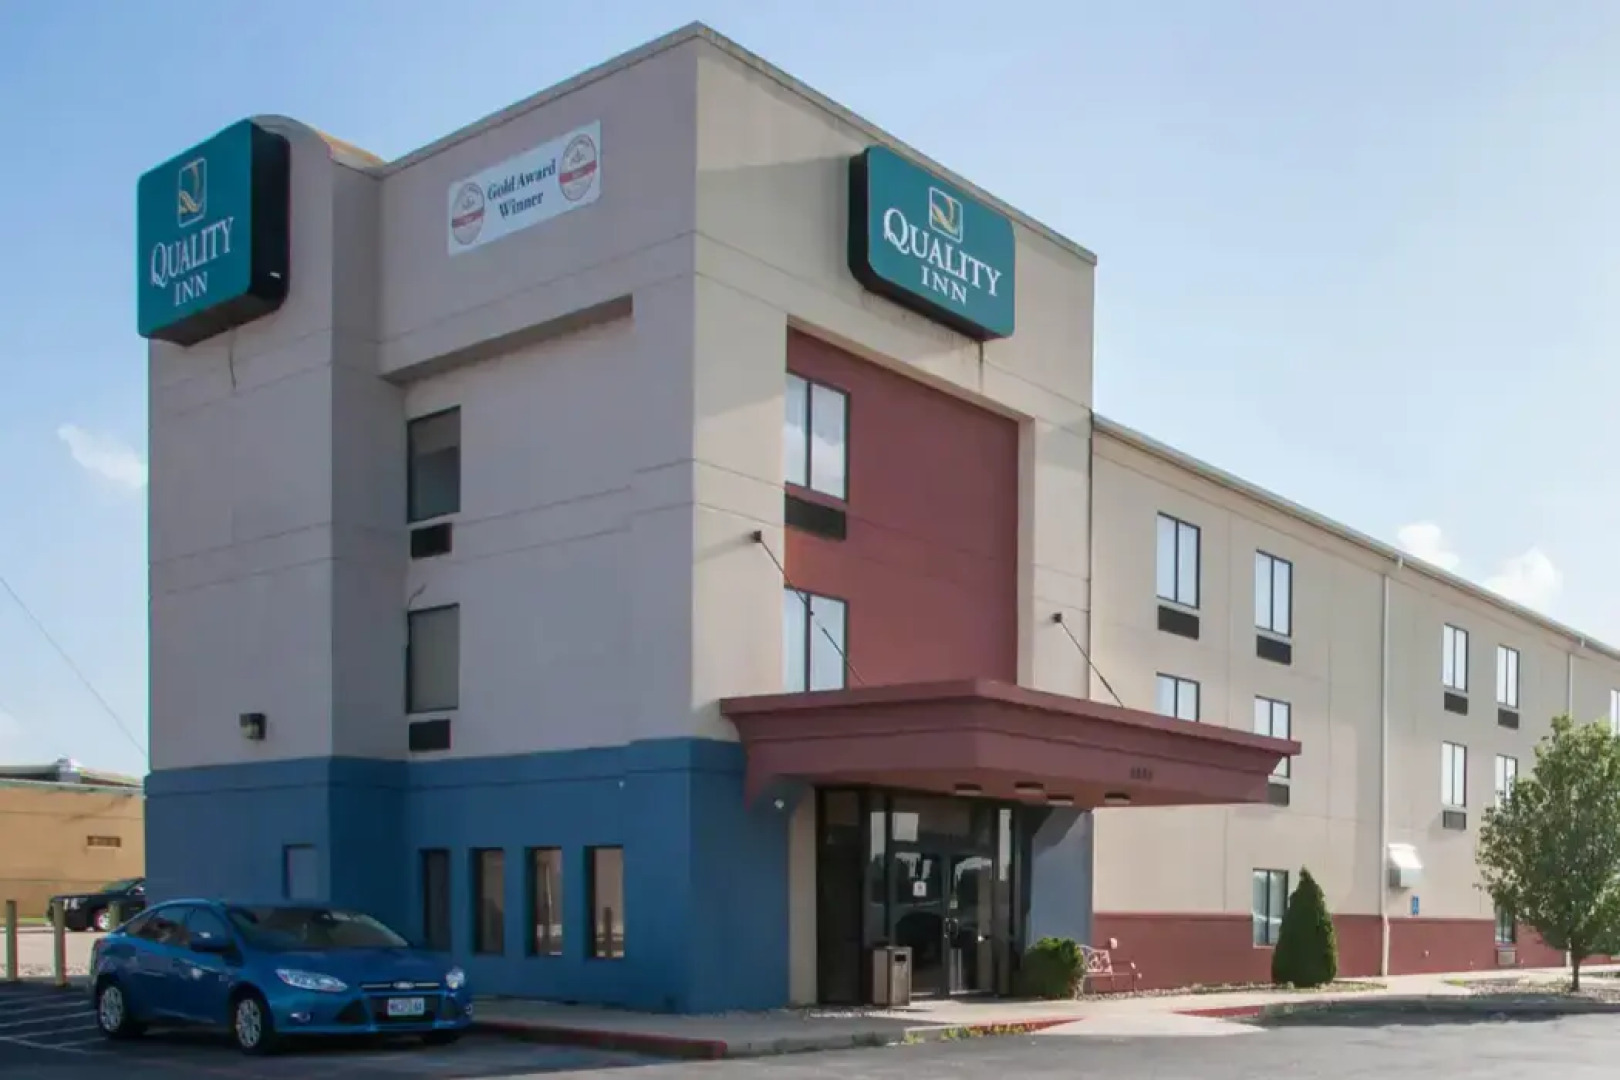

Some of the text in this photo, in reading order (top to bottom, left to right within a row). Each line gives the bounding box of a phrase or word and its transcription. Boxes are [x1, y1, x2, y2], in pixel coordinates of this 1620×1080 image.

[487, 174, 515, 201] Gold
[517, 158, 557, 188] Award
[499, 192, 544, 218] Winner
[151, 216, 234, 288] QUALITY
[883, 207, 1002, 297] QUALITY
[173, 271, 208, 307] INN
[921, 265, 967, 305] INN
